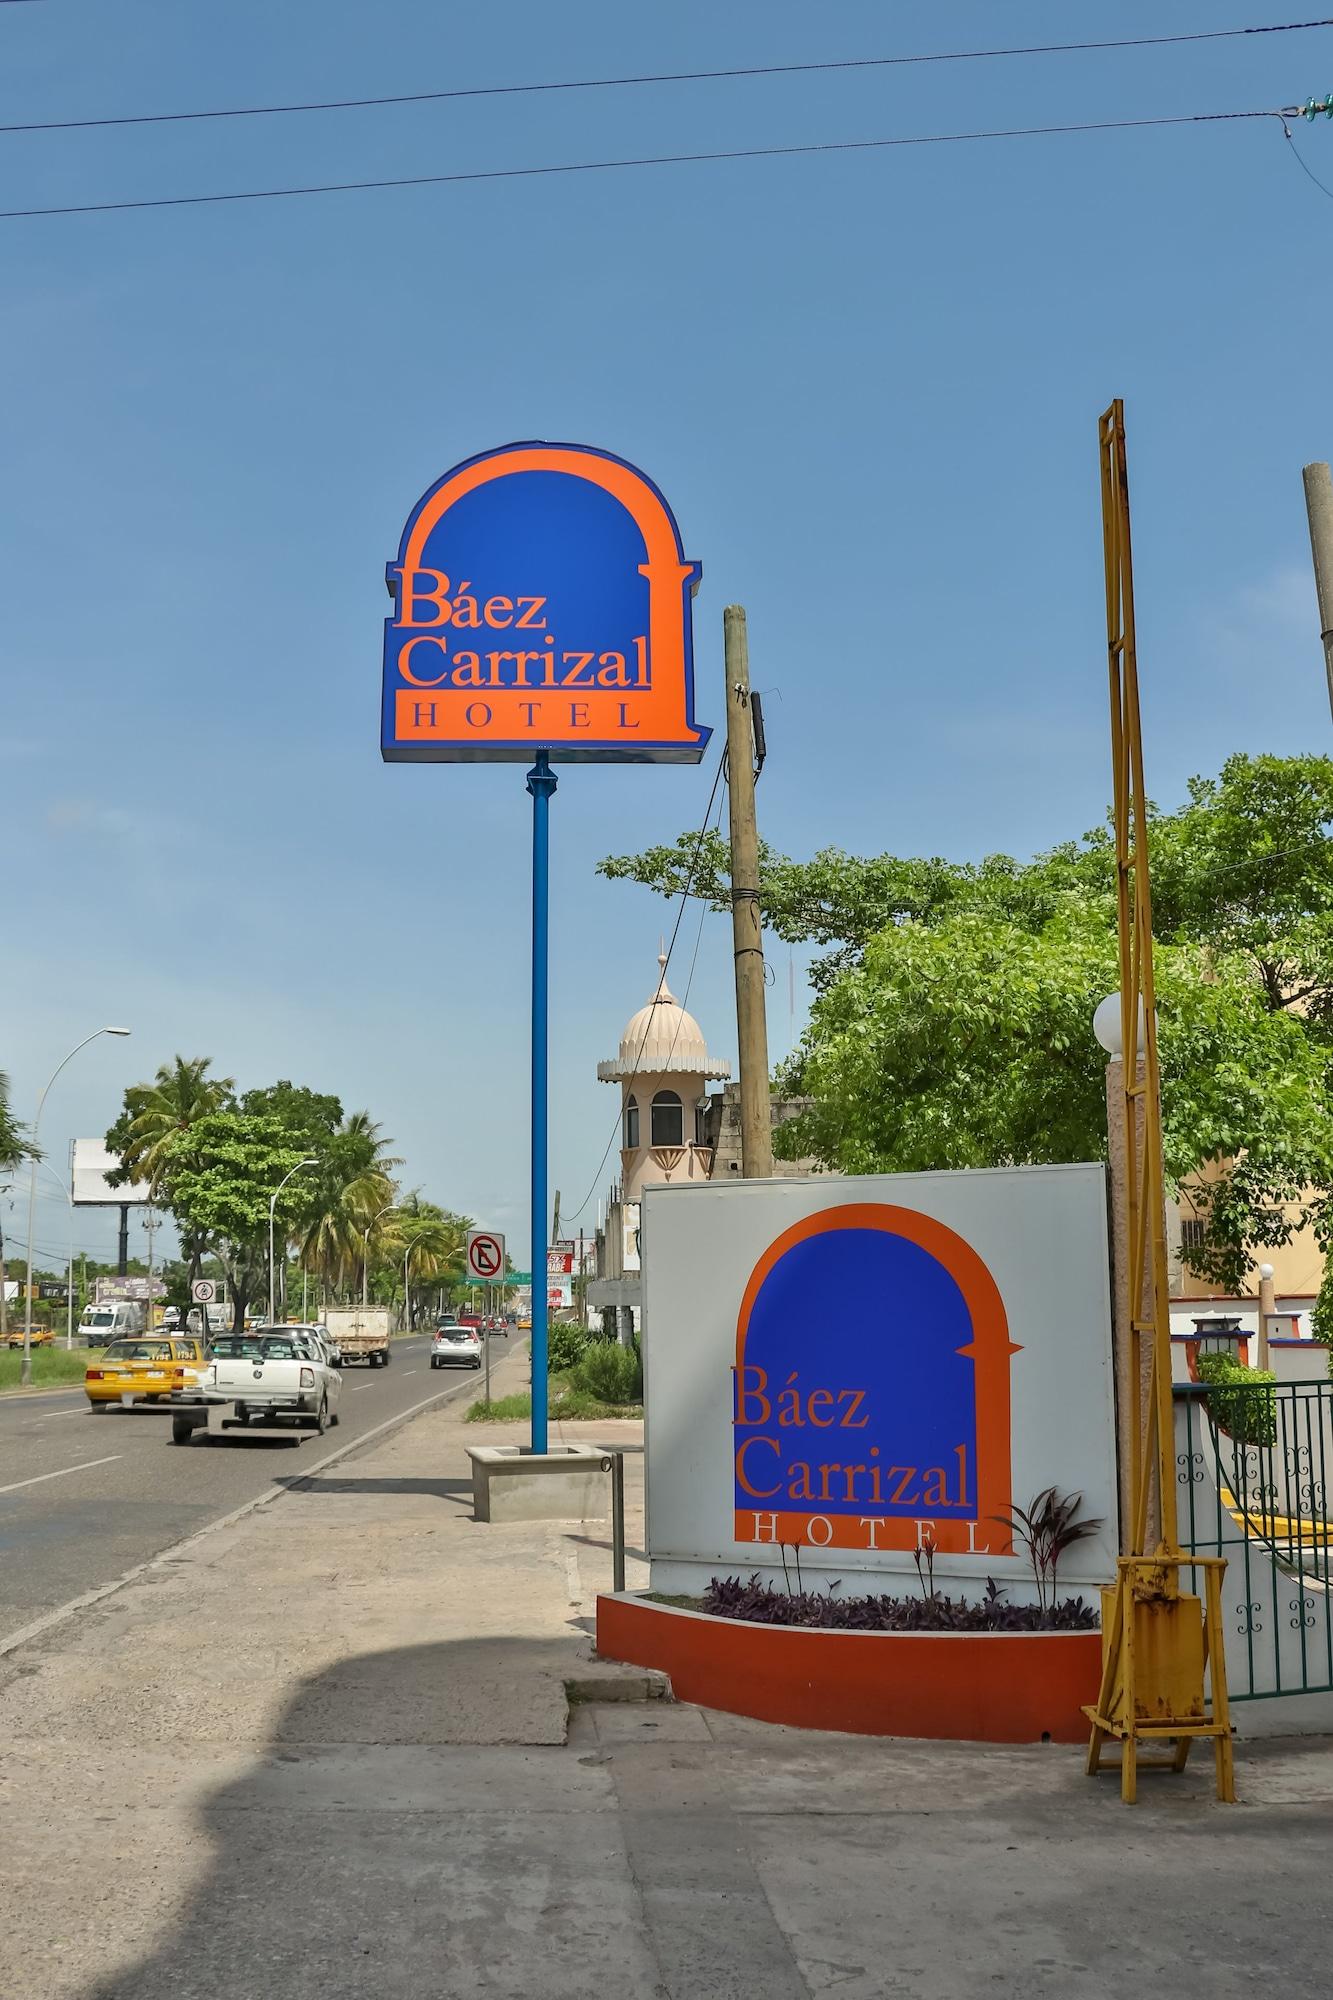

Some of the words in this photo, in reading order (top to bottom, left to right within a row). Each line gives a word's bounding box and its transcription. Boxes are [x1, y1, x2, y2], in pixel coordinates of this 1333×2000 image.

[392, 567, 547, 629] Báez
[397, 635, 652, 687] Carrizal
[411, 702, 641, 728] HOTEL
[730, 1365, 870, 1428] Báez
[735, 1435, 973, 1508] Carrizal
[752, 1513, 990, 1554] HOTEL
